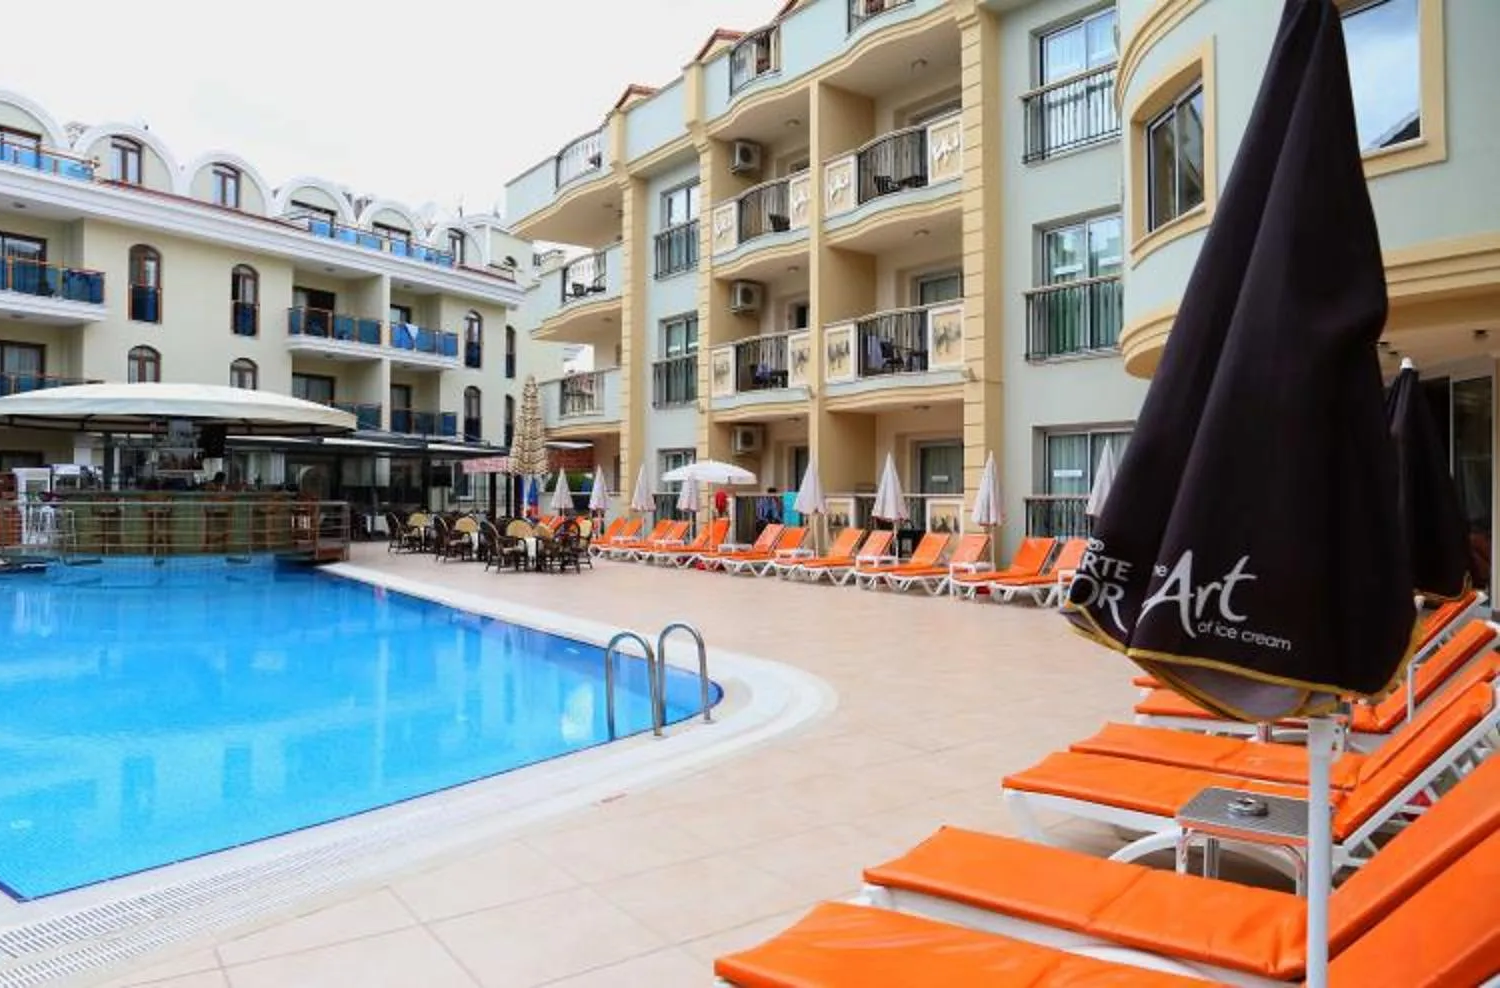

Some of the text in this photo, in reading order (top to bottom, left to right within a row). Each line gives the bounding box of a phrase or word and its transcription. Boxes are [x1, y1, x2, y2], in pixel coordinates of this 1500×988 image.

[1082, 551, 1133, 581] RTE
[1067, 573, 1128, 633] OR
[1135, 549, 1258, 638] Art
[1198, 621, 1291, 650] of ice cream
